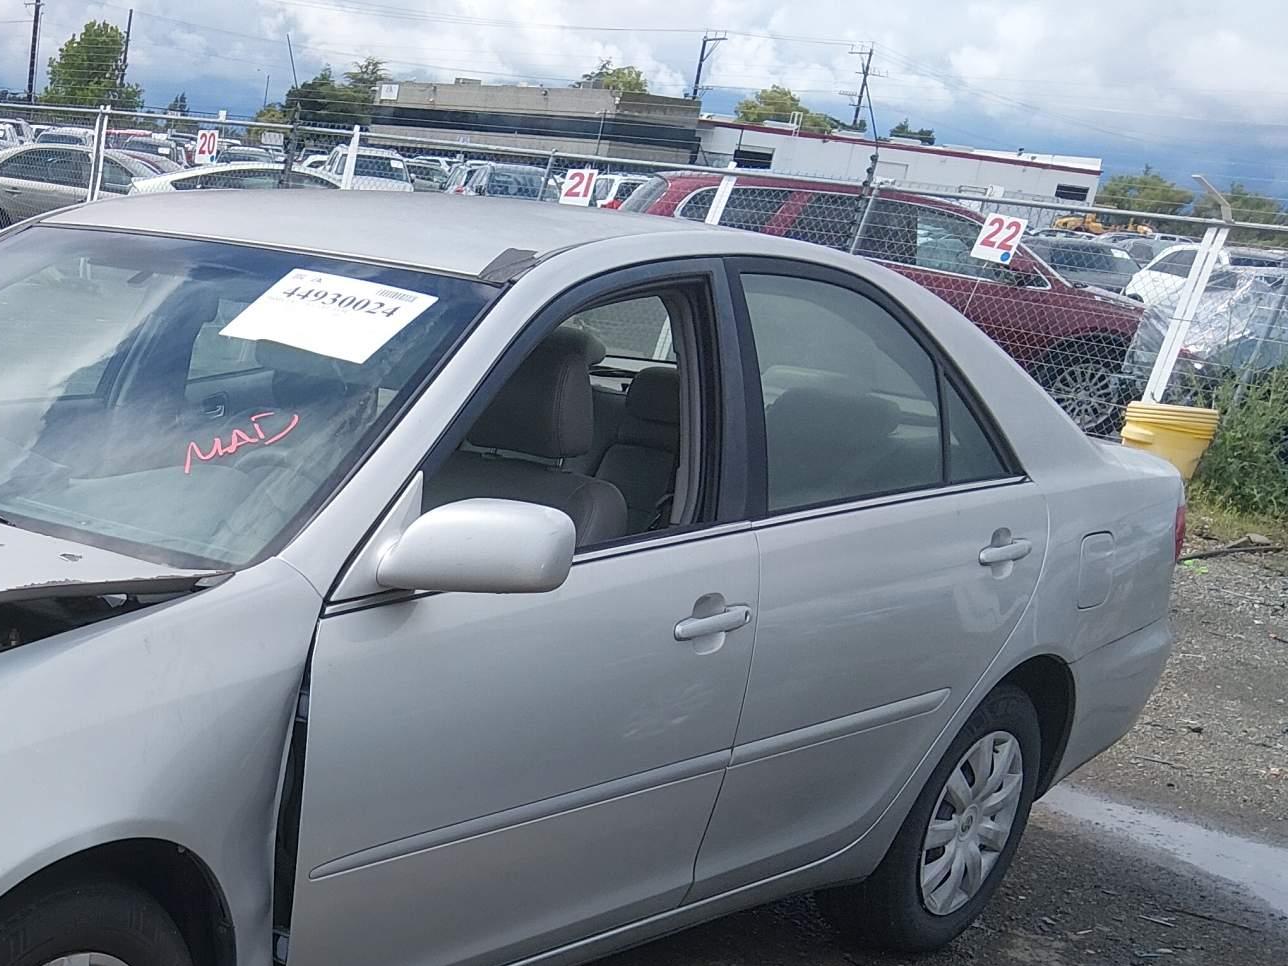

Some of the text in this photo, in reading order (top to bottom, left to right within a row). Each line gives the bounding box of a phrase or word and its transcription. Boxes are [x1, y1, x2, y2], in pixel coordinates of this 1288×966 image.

[198, 132, 216, 155] 20
[564, 172, 595, 198] 21
[979, 217, 1022, 252] 22
[282, 286, 401, 318] 44930024
